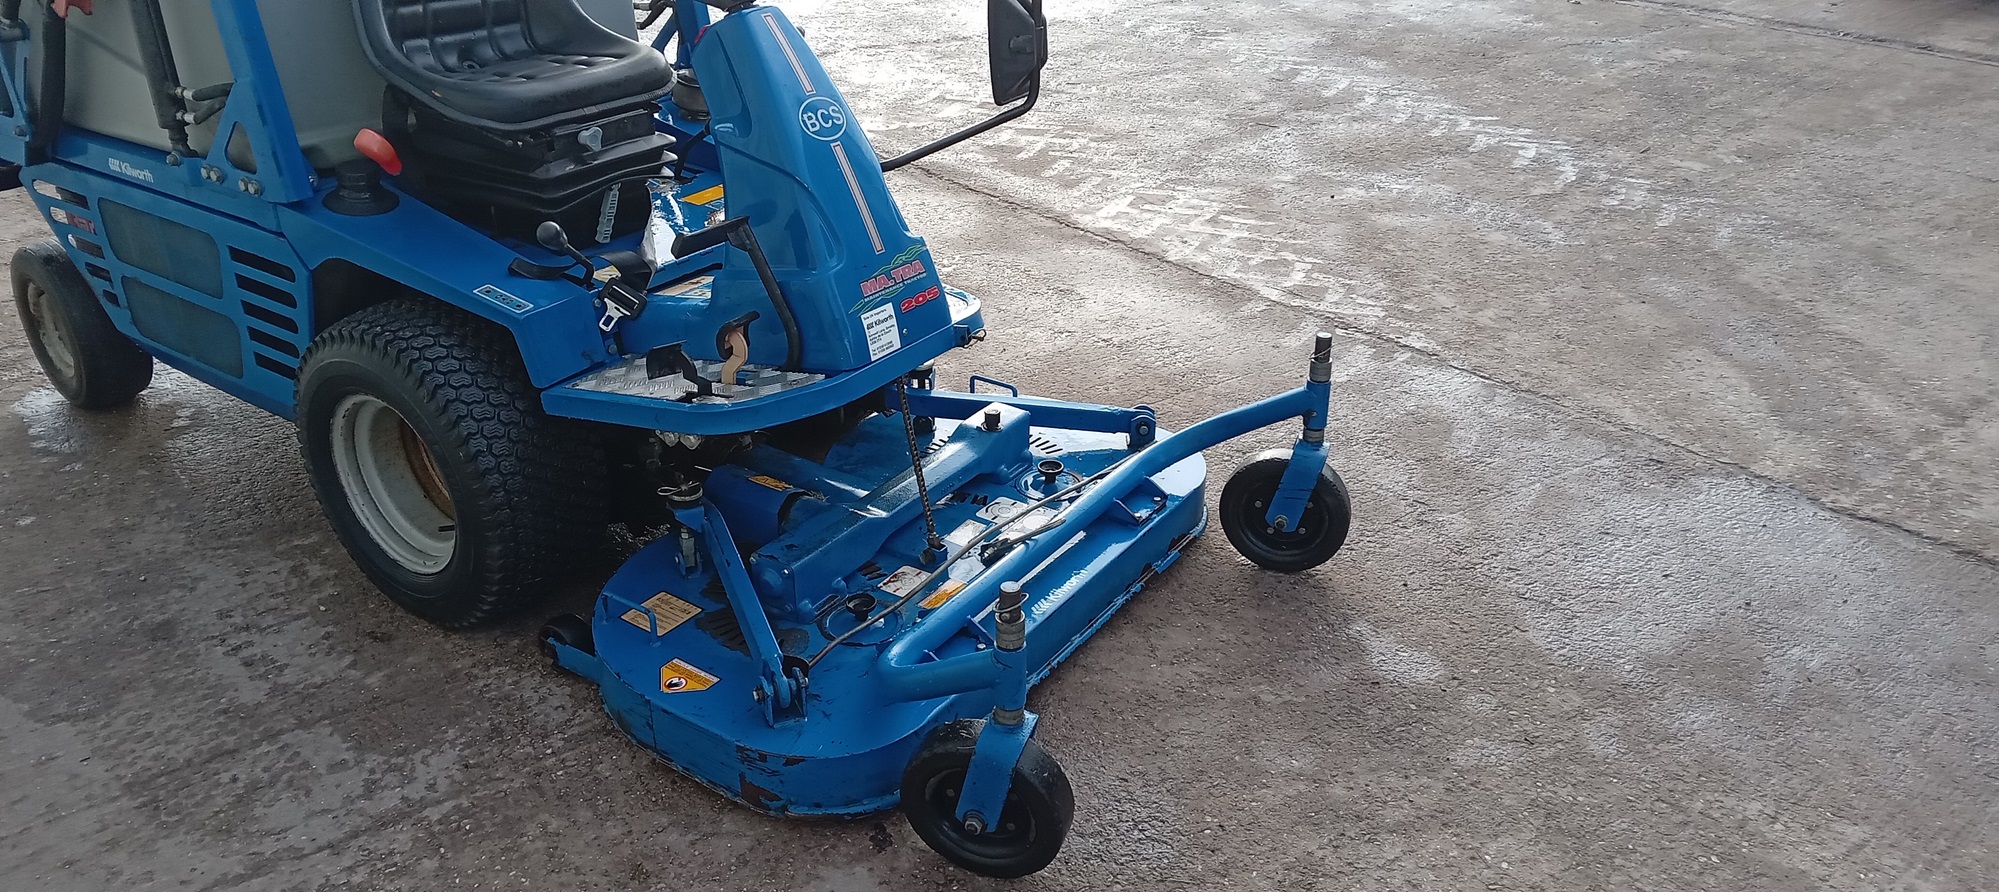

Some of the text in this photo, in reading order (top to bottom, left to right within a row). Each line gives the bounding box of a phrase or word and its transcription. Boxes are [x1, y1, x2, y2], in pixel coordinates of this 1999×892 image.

[802, 105, 844, 132] BCS
[120, 161, 154, 183] Kilworth
[860, 260, 926, 296] MA.TRA
[864, 283, 904, 302] MAINTENANCE
[900, 286, 940, 313] 205
[874, 313, 894, 327] Kilworth
[1045, 569, 1089, 602] Kilworth
